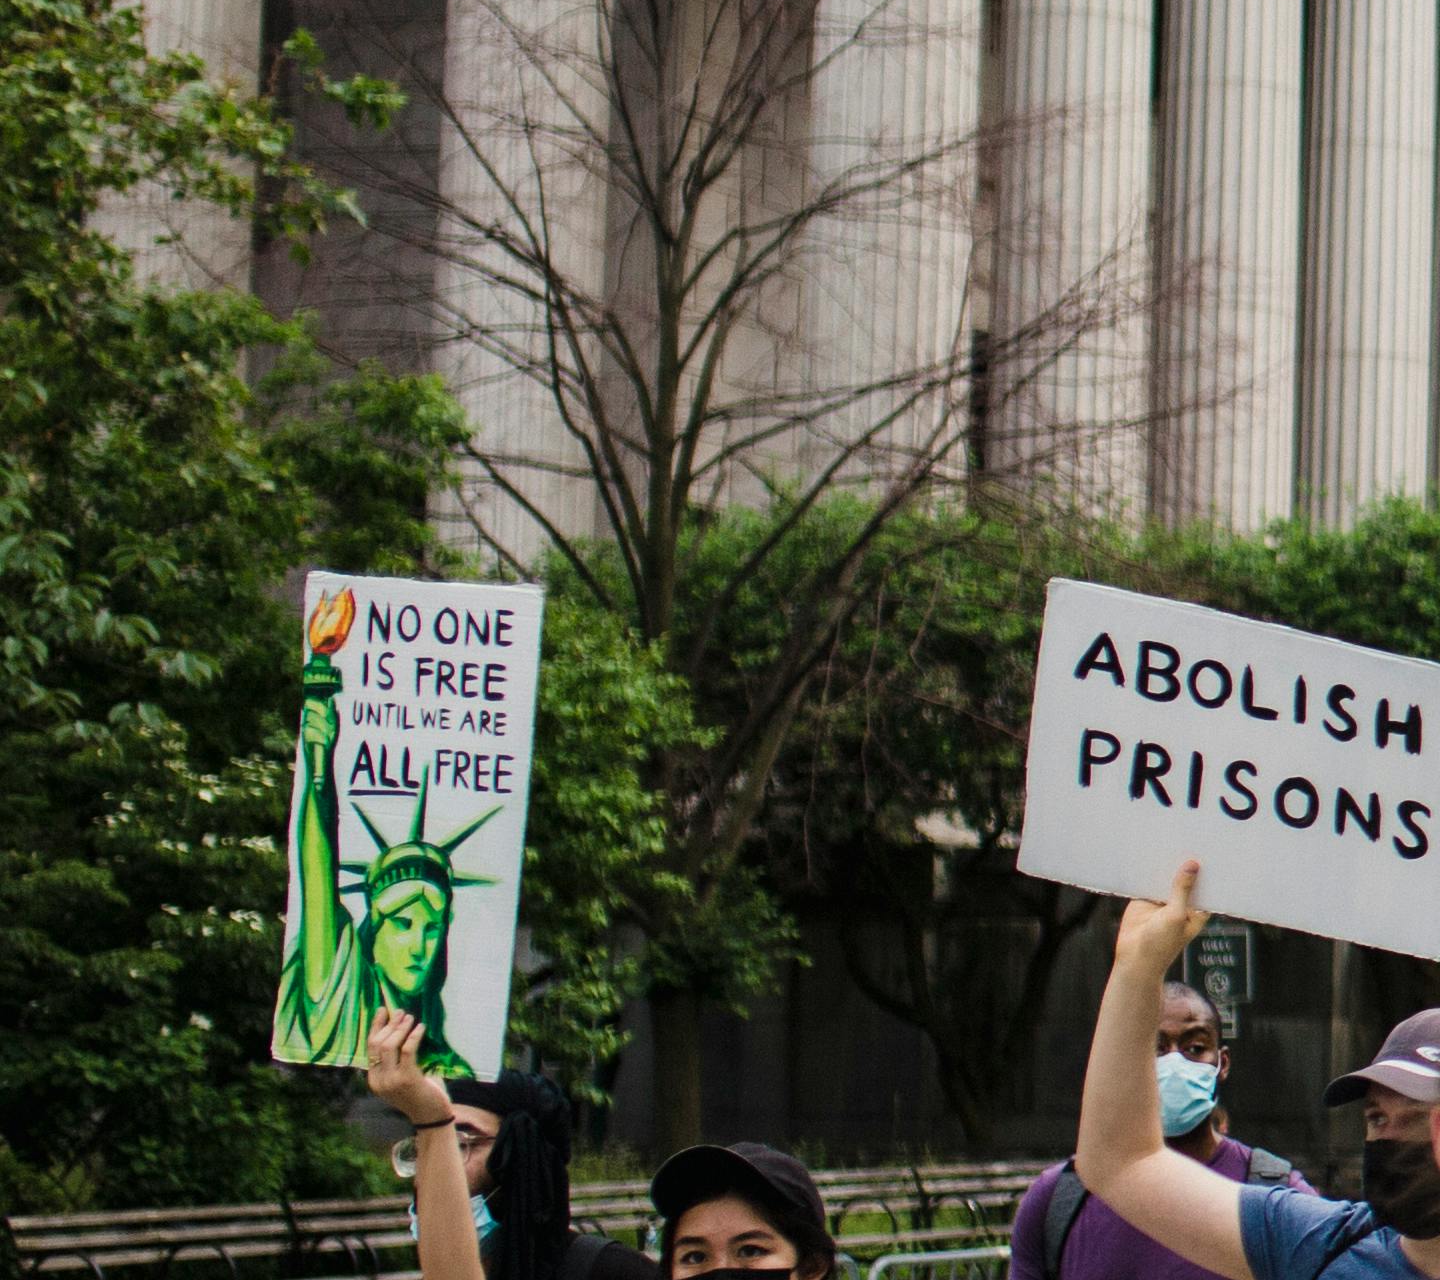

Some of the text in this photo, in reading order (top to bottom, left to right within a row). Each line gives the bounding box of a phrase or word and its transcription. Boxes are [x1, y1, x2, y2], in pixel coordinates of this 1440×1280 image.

[368, 600, 515, 647] NO ONE
[362, 652, 508, 702] IS FREE
[1073, 631, 1424, 755] ABOLISH
[353, 700, 508, 736] UNTIL WE ARE
[350, 740, 515, 794] ALL FREE
[1078, 731, 1433, 861] PRISONS
